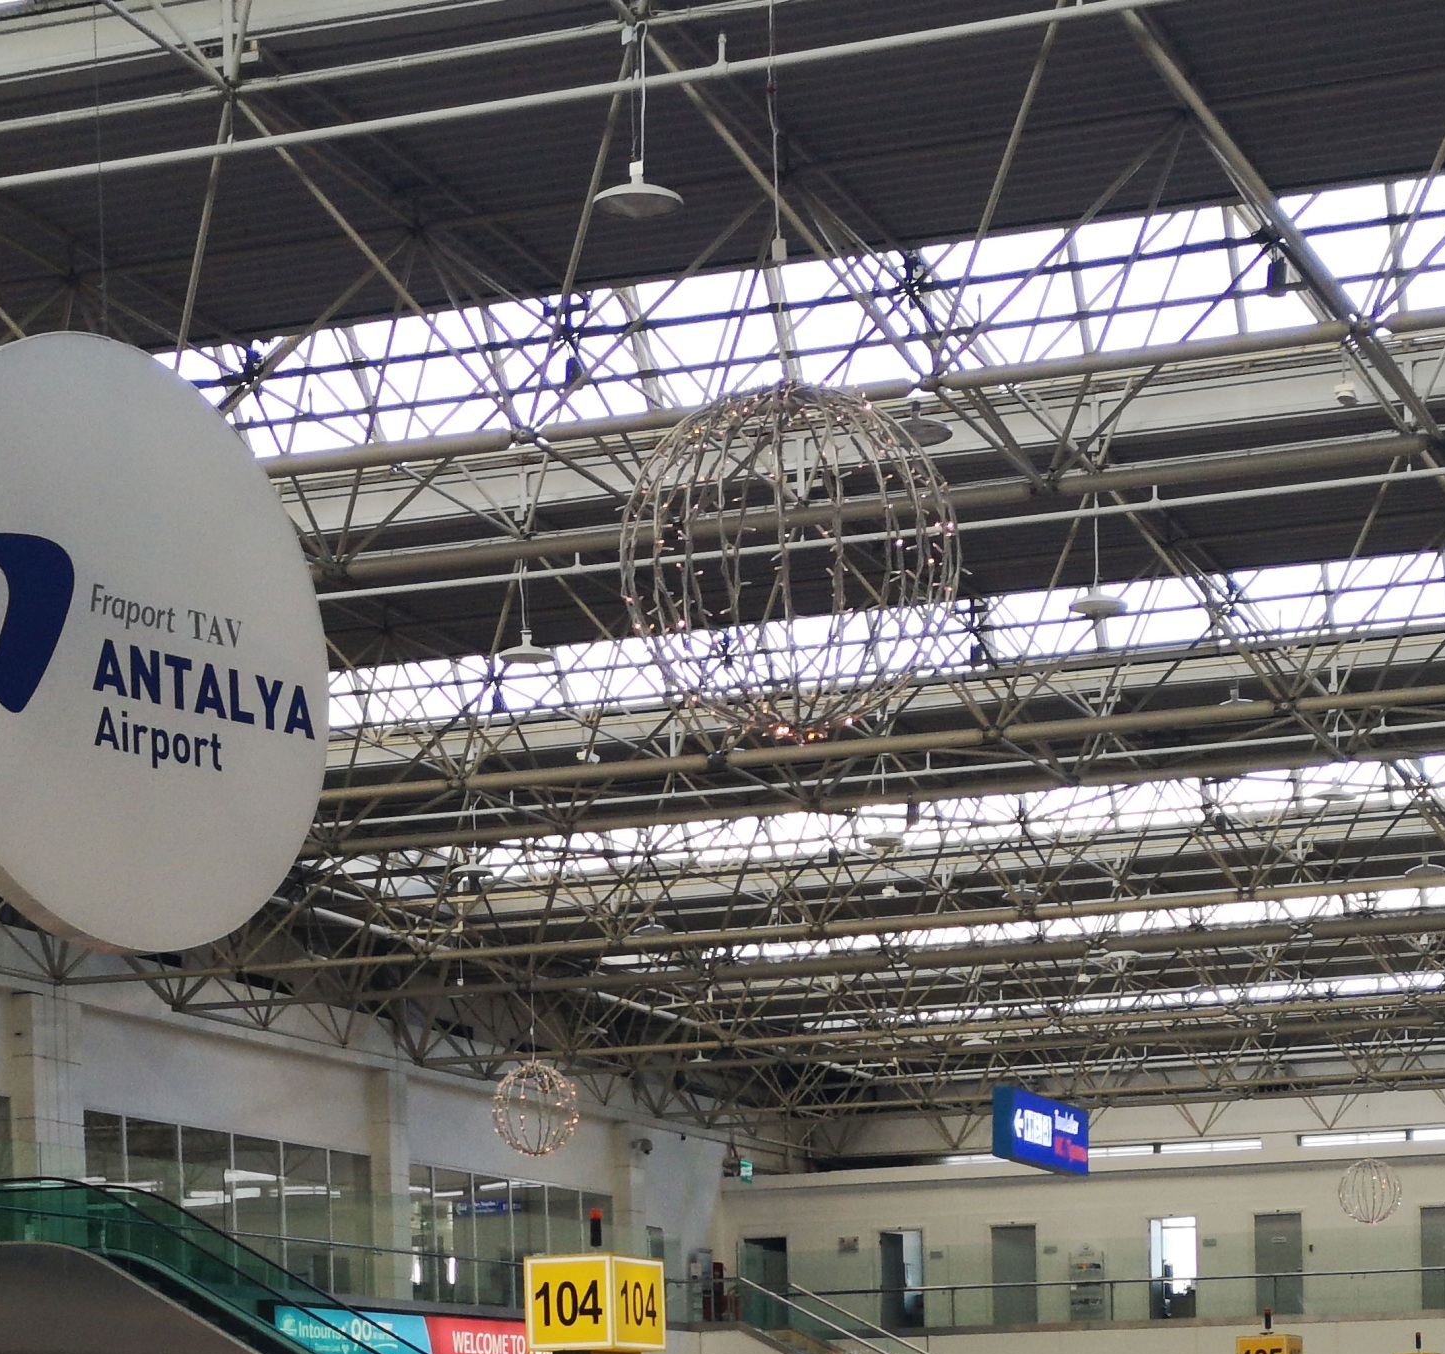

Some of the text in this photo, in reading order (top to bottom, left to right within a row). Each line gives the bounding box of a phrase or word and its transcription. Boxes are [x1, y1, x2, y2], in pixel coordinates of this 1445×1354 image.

[90, 583, 243, 649] Fraport TAV
[92, 638, 316, 740] ANTALYA
[93, 706, 223, 771] Airport
[534, 1279, 603, 1327] 104
[620, 1280, 657, 1327] 104
